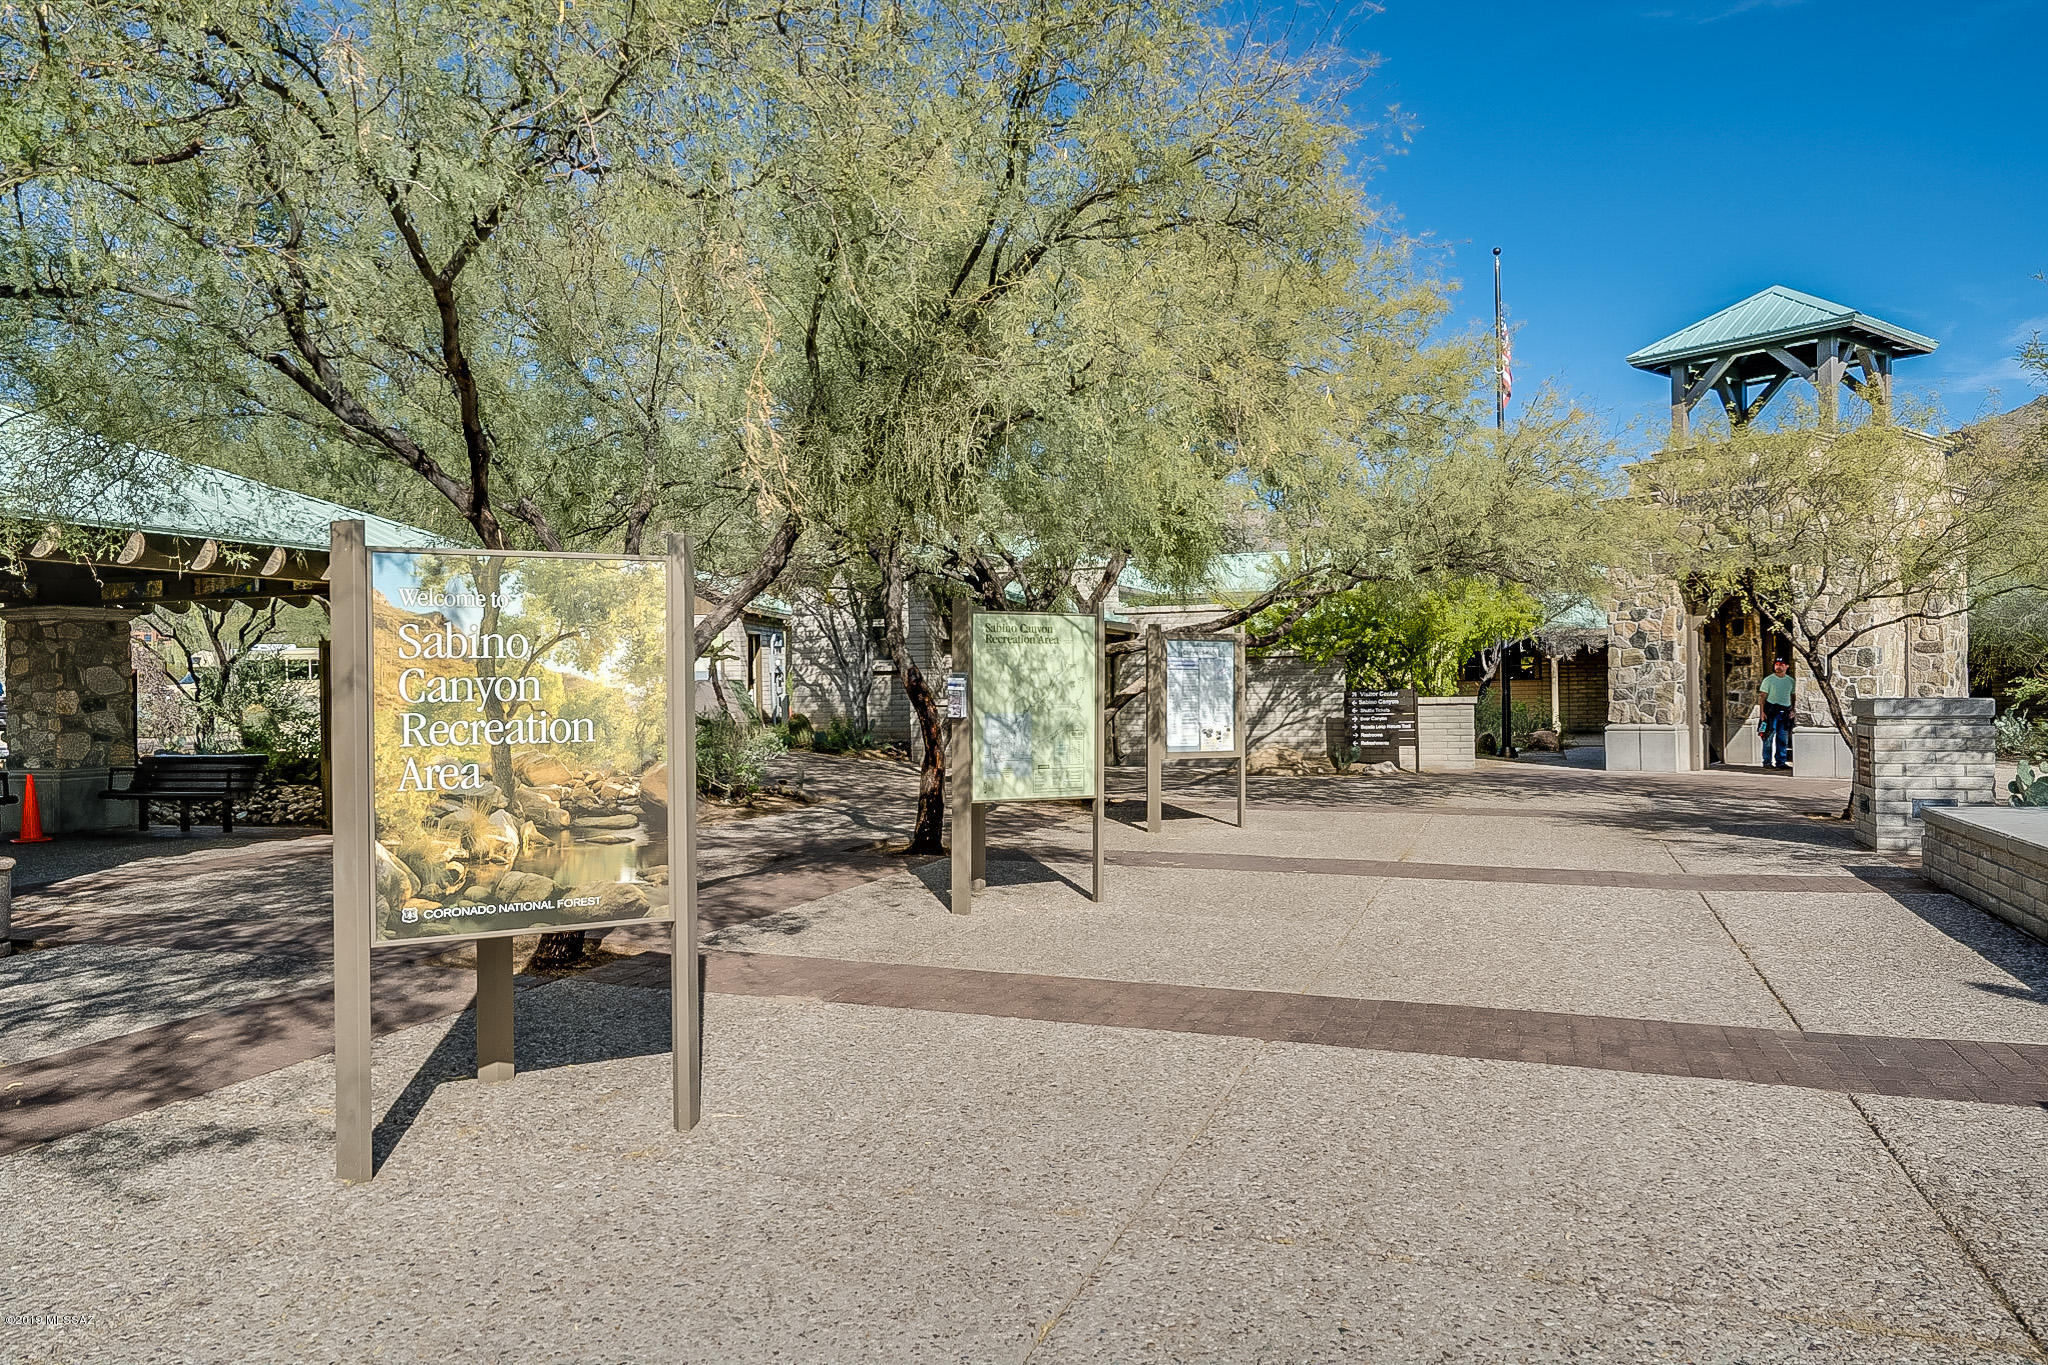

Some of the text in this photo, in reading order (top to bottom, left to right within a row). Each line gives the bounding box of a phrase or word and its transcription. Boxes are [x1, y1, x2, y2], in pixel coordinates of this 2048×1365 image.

[398, 587, 510, 609] Welcome to
[398, 621, 529, 660] Sabino
[985, 622, 1053, 636] Sabino Canyon
[985, 634, 1060, 645] Recreation Area
[398, 667, 542, 712] Canyon
[400, 710, 596, 748] Recreation
[398, 756, 485, 792] Area
[423, 896, 602, 920] CORONADO NATIONAL FOREST
